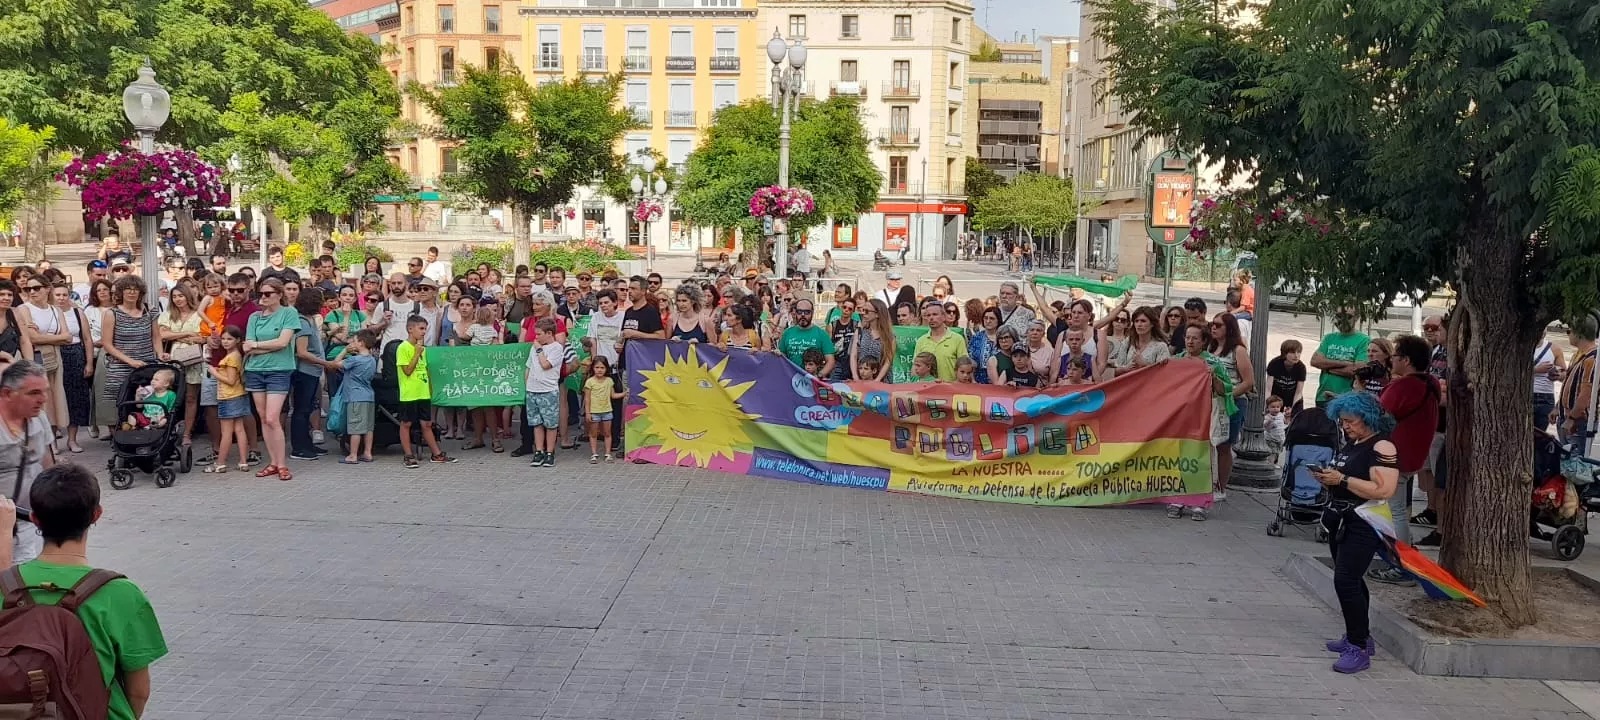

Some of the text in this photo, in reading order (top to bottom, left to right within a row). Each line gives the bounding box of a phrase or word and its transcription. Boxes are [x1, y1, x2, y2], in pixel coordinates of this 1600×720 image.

[952, 467, 968, 476] LA
[973, 461, 1032, 477] NUESTRA
[1076, 461, 1121, 479] TODOS
[1125, 456, 1199, 474] PINTAMOS
[968, 485, 979, 495] en
[983, 480, 1025, 498] Defensa
[1030, 481, 1043, 499] de
[1047, 481, 1056, 499] la
[1059, 481, 1098, 500] Escuela
[1102, 475, 1142, 496] Pública
[1146, 474, 1187, 493] HUESCA
